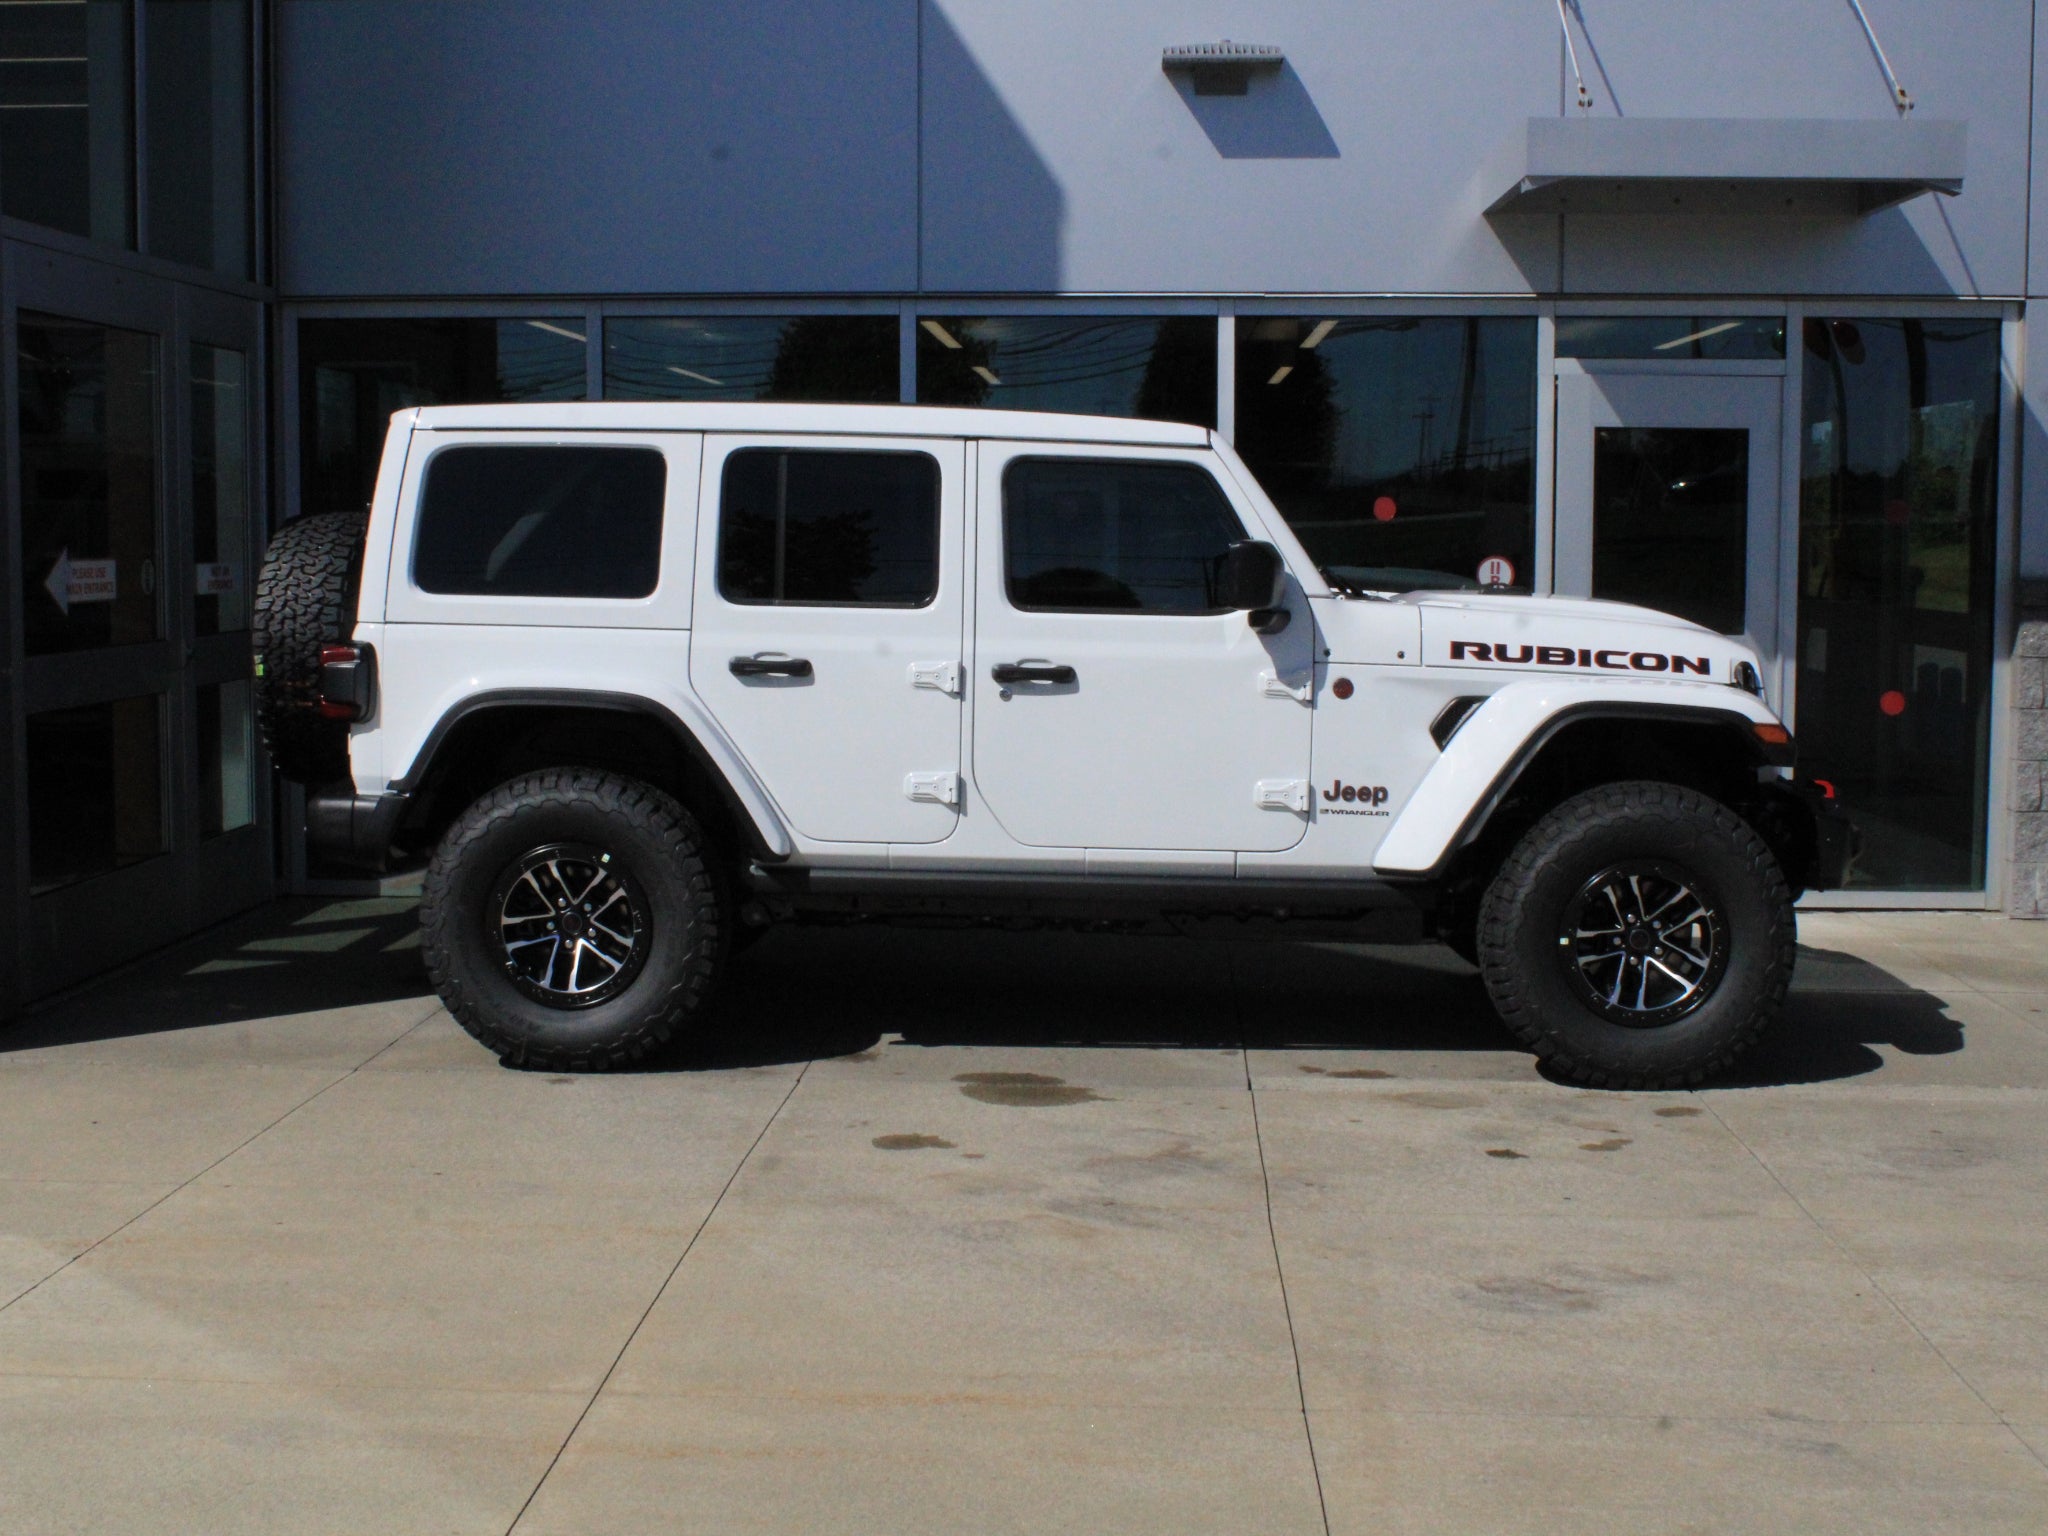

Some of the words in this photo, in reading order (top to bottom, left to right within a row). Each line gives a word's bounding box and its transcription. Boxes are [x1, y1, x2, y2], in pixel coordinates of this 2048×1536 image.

[1450, 641, 1711, 676] RUBICON
[1323, 780, 1389, 807] Jeep
[1330, 809, 1390, 817] WRANGLER
